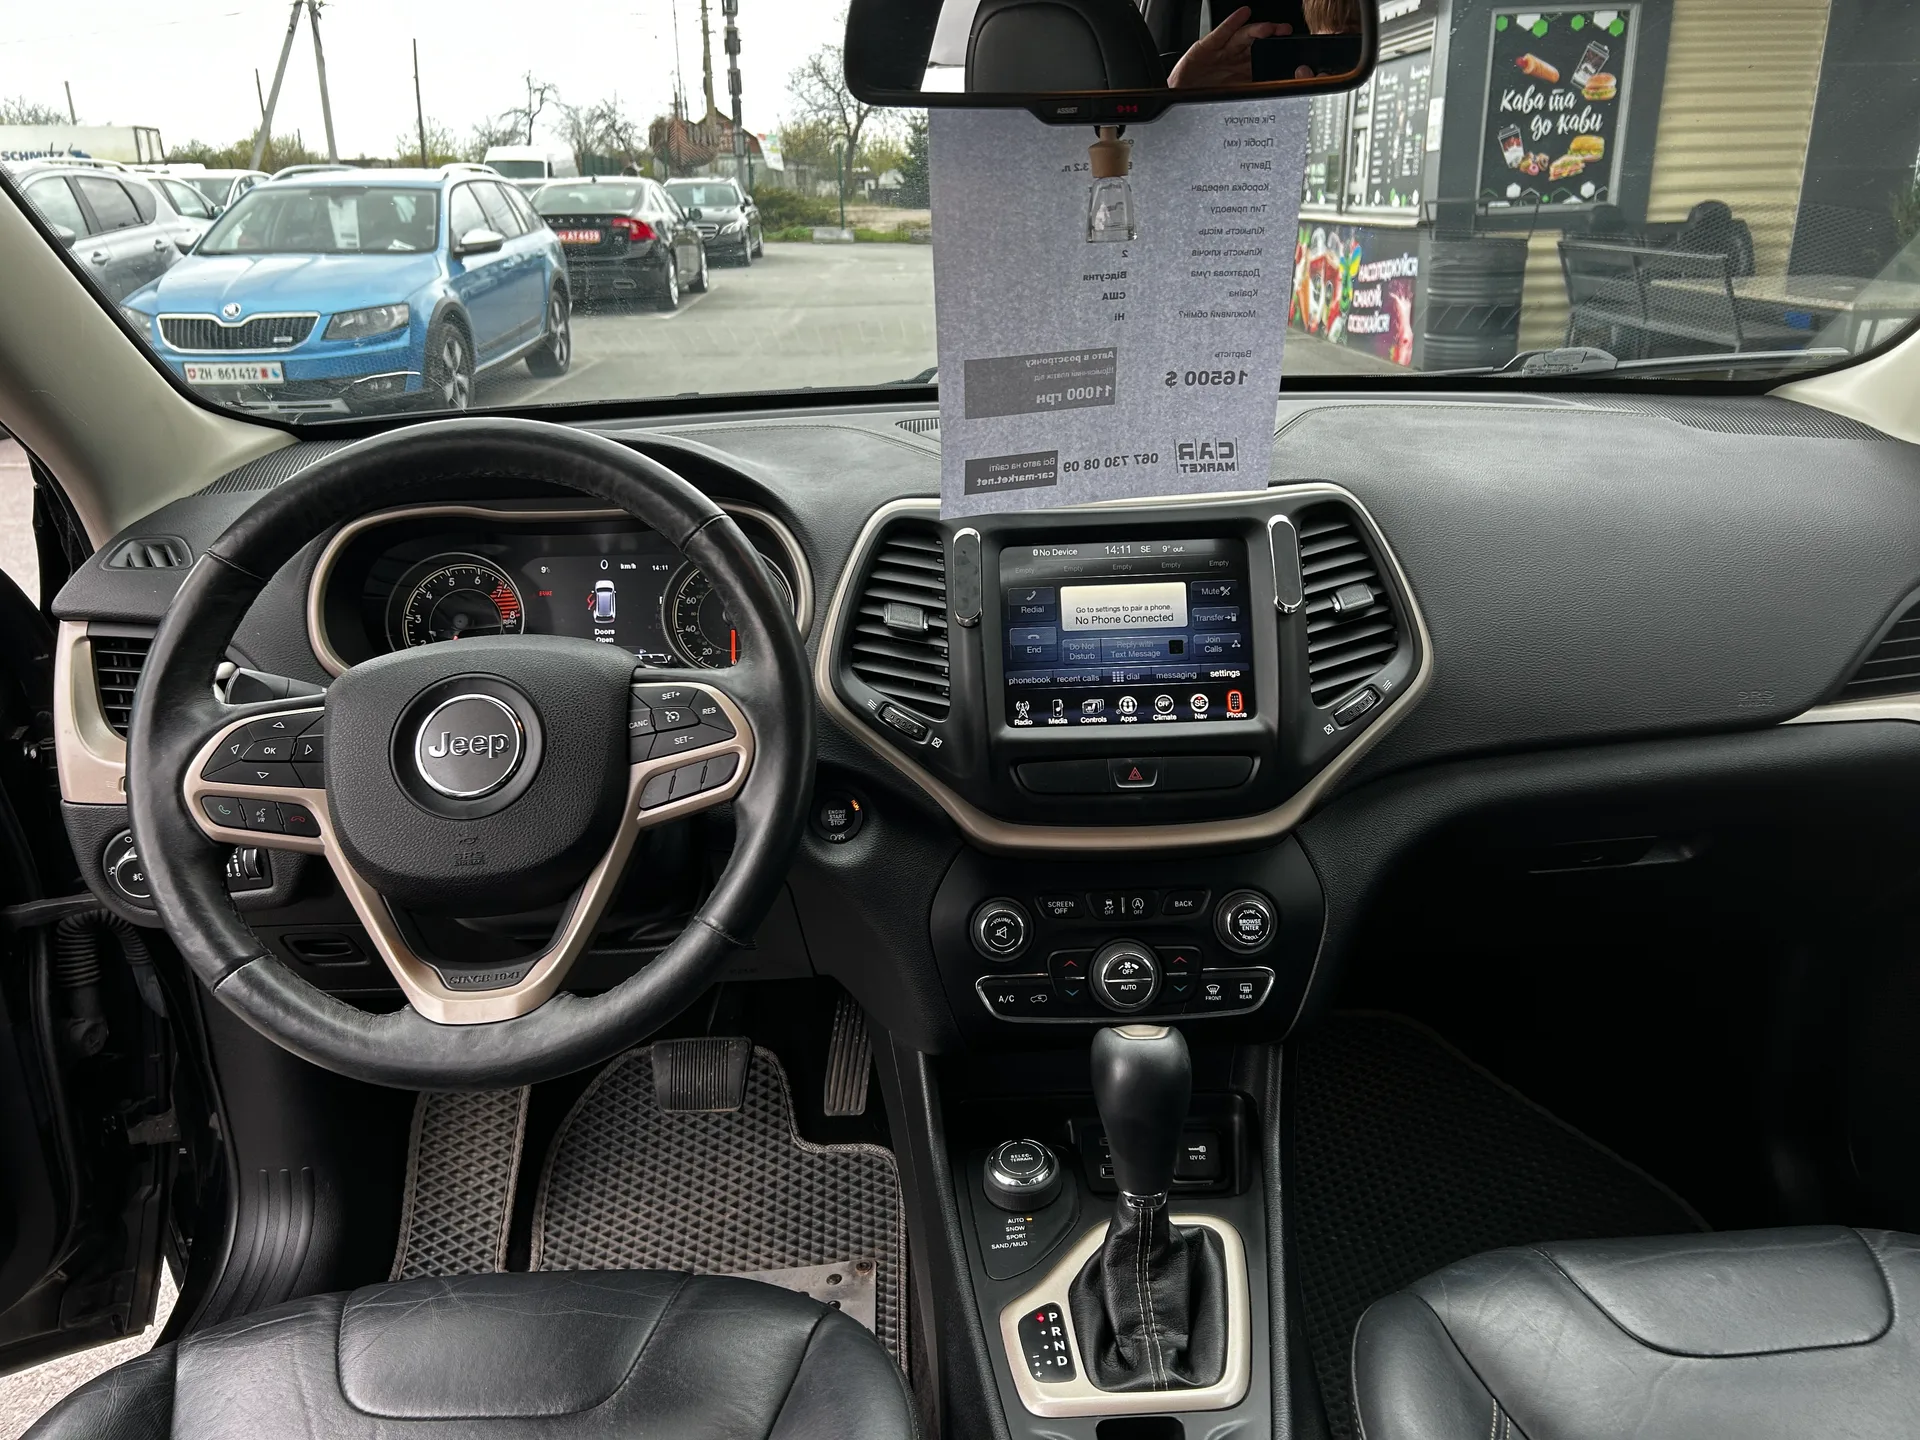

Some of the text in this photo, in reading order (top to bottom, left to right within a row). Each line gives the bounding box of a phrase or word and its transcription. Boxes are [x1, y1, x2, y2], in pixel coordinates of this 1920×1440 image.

[1500, 84, 1546, 114] Кава
[1530, 105, 1603, 141] до кави
[200, 367, 259, 380] ZH 861412
[1052, 548, 1078, 556] Device
[1104, 545, 1131, 555] 14:11
[1140, 545, 1151, 553] SE
[600, 559, 609, 570] 0
[1112, 563, 1133, 571] Empty
[1015, 567, 1035, 575] Empty
[1063, 565, 1084, 573] Empty
[448, 577, 455, 586] 5
[474, 576, 481, 585] 6
[425, 591, 433, 600] 4
[496, 589, 502, 598] 7
[686, 597, 697, 605] 60
[1095, 605, 1121, 614] settings
[1130, 605, 1143, 613] pair
[1150, 604, 1173, 612] phone.
[415, 615, 422, 623] 3
[509, 611, 516, 619] 8
[1075, 613, 1174, 624] No Phone Connected
[1196, 614, 1225, 622] Transfer
[685, 625, 696, 633] 40
[1116, 641, 1138, 649] Reply
[1204, 645, 1223, 653] Calls
[702, 648, 713, 656] 20
[1026, 646, 1042, 654] End
[1111, 650, 1161, 658] Text Message
[1069, 652, 1096, 660] Disturb
[1126, 672, 1140, 680] dial
[1156, 671, 1197, 679] messaging
[1209, 669, 1241, 678] settings
[1008, 676, 1051, 686] phonebook
[702, 707, 717, 715] RES
[629, 719, 649, 729] CANC
[428, 731, 510, 759] Jeep
[263, 747, 276, 755] OK
[1174, 900, 1193, 908] BACK
[998, 995, 1015, 1003] A/C
[991, 1241, 1028, 1249] SAND/MUD
[1048, 1312, 1058, 1322] P
[1051, 1326, 1062, 1337] R
[1053, 1340, 1066, 1351] N
[1056, 1355, 1068, 1366] D
